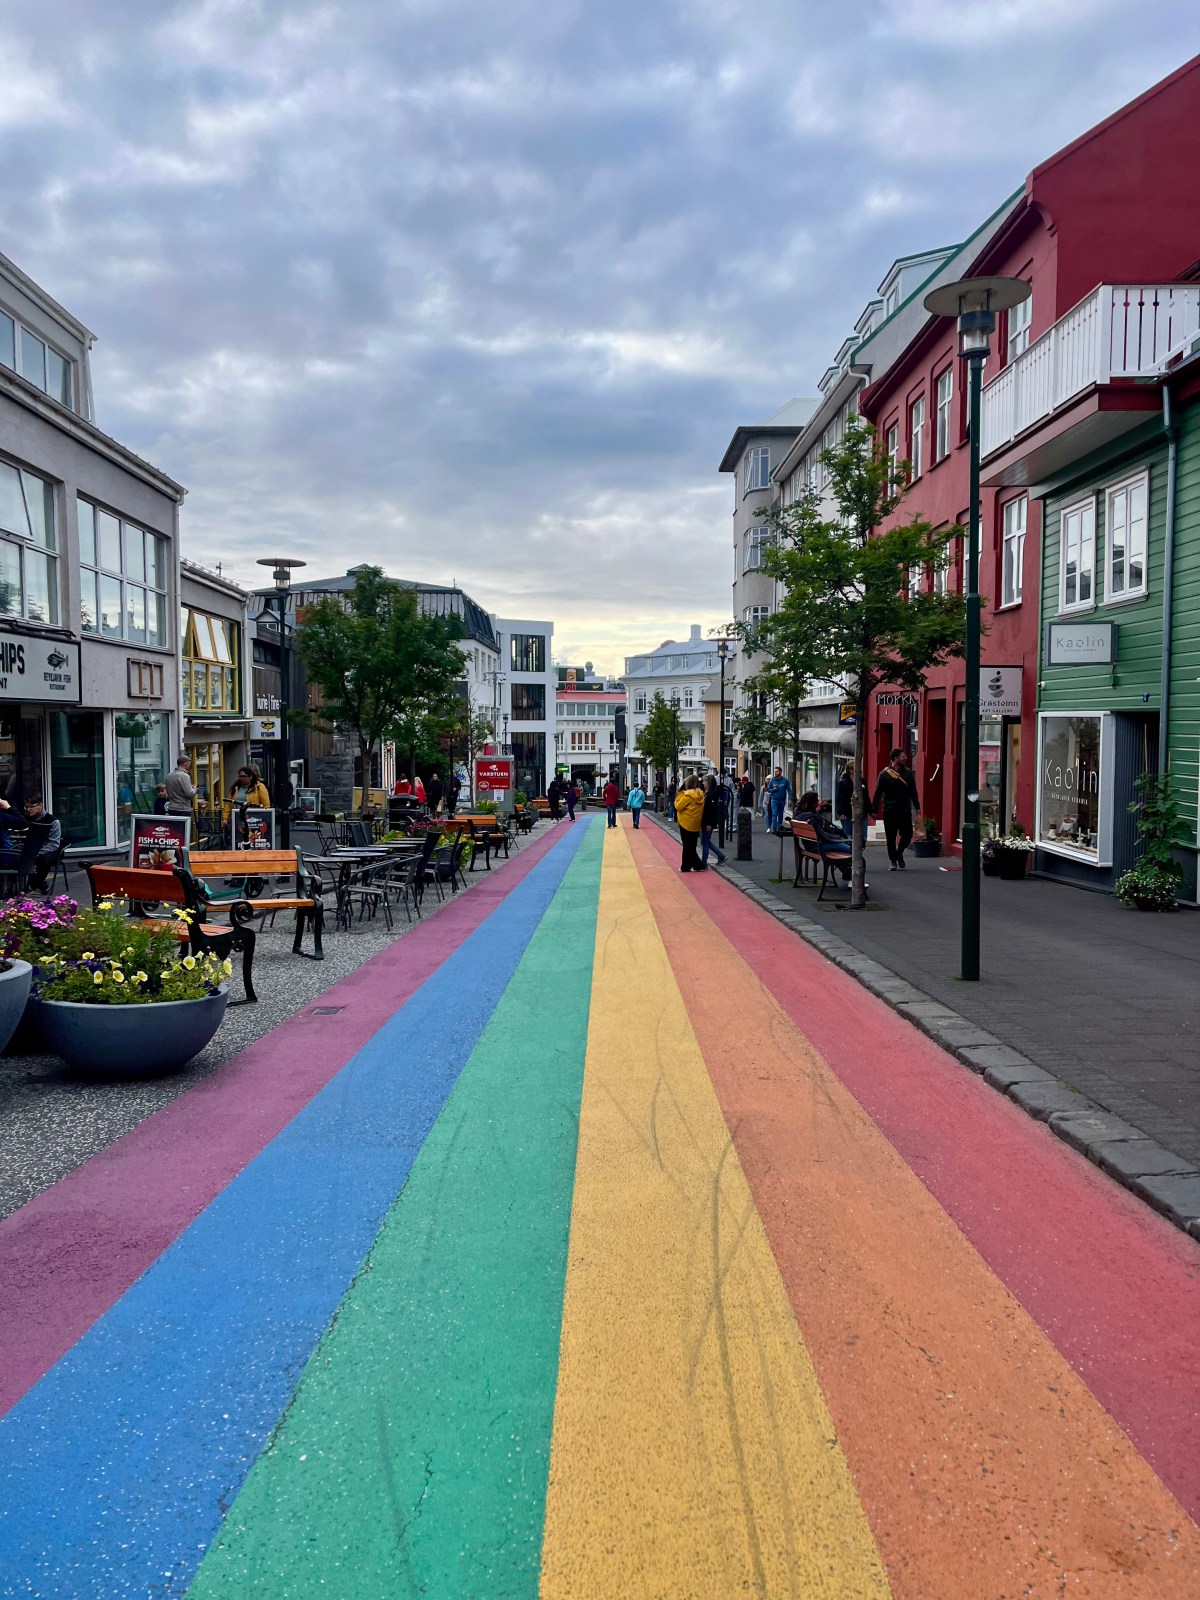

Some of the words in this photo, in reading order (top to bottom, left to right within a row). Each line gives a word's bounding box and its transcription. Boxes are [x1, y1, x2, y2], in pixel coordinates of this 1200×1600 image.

[1056, 635, 1104, 648] Kaolin
[1044, 758, 1097, 794] Kaolin
[158, 838, 180, 846] CHIPS
